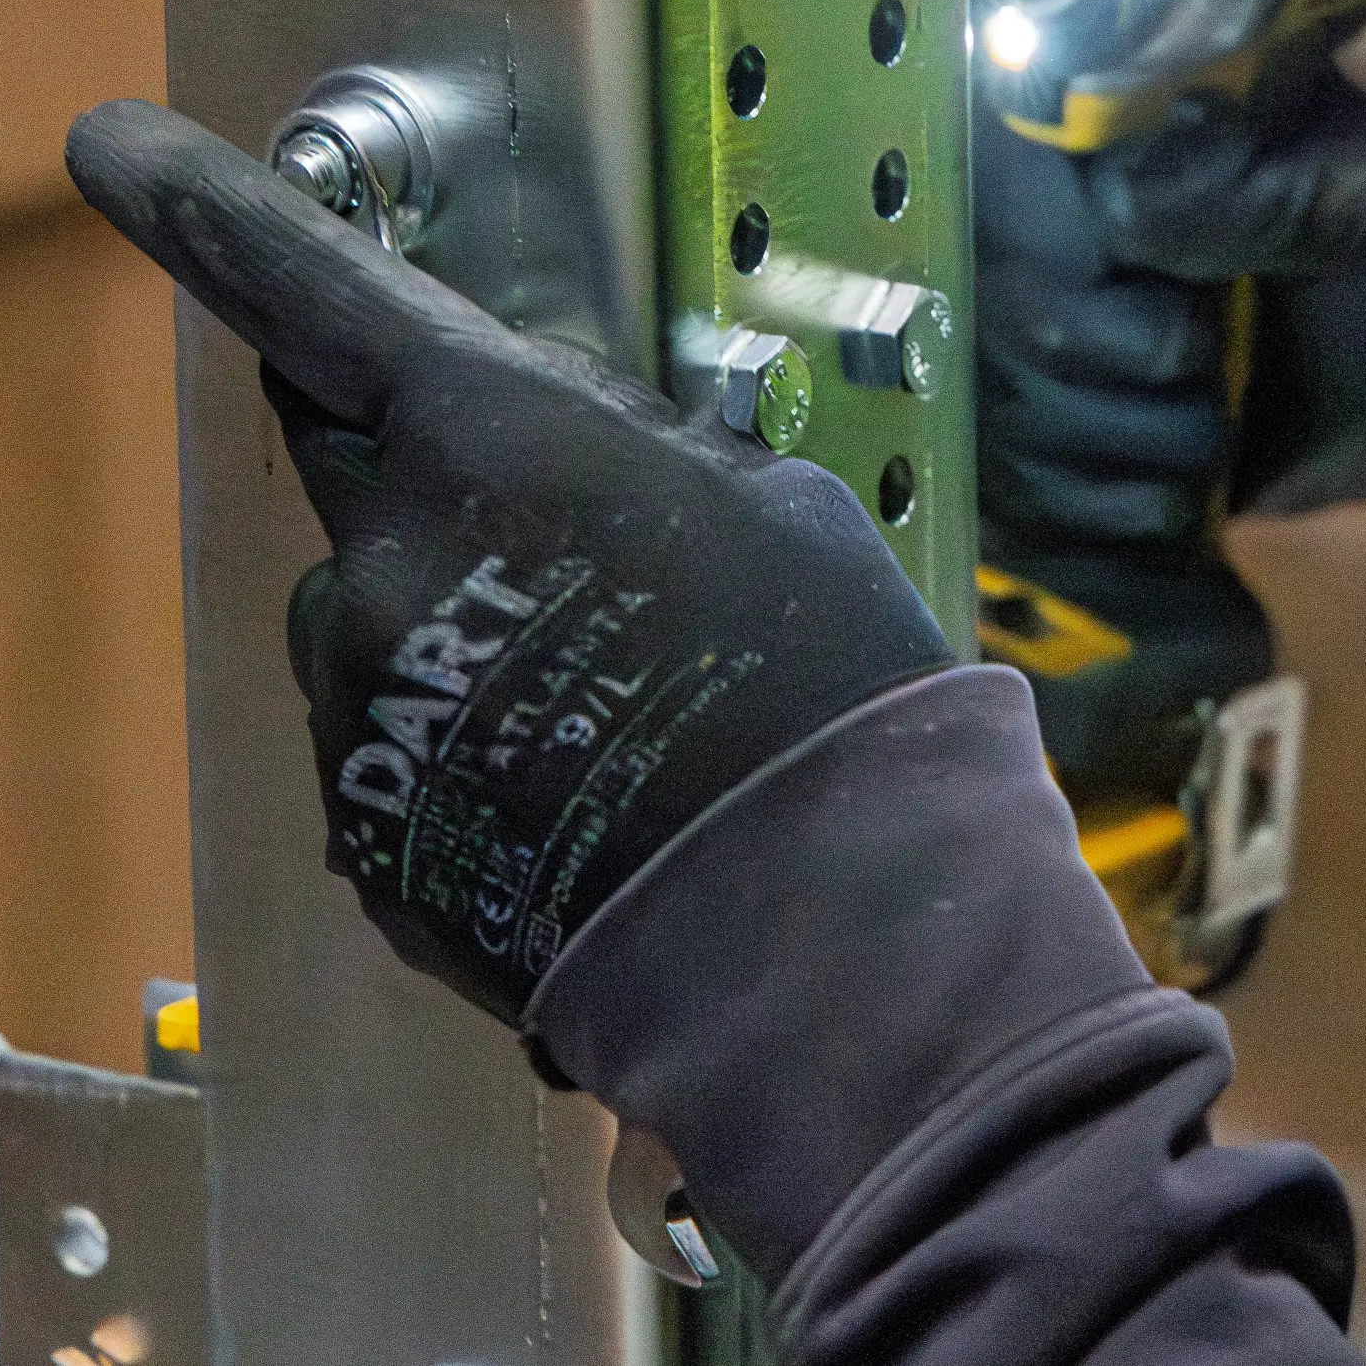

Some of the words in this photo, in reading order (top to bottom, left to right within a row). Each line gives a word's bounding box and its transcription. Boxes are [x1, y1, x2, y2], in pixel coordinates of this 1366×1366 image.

[339, 555, 539, 819] DART
[485, 591, 655, 770] ATLANTA
[555, 658, 659, 749] 9/L
